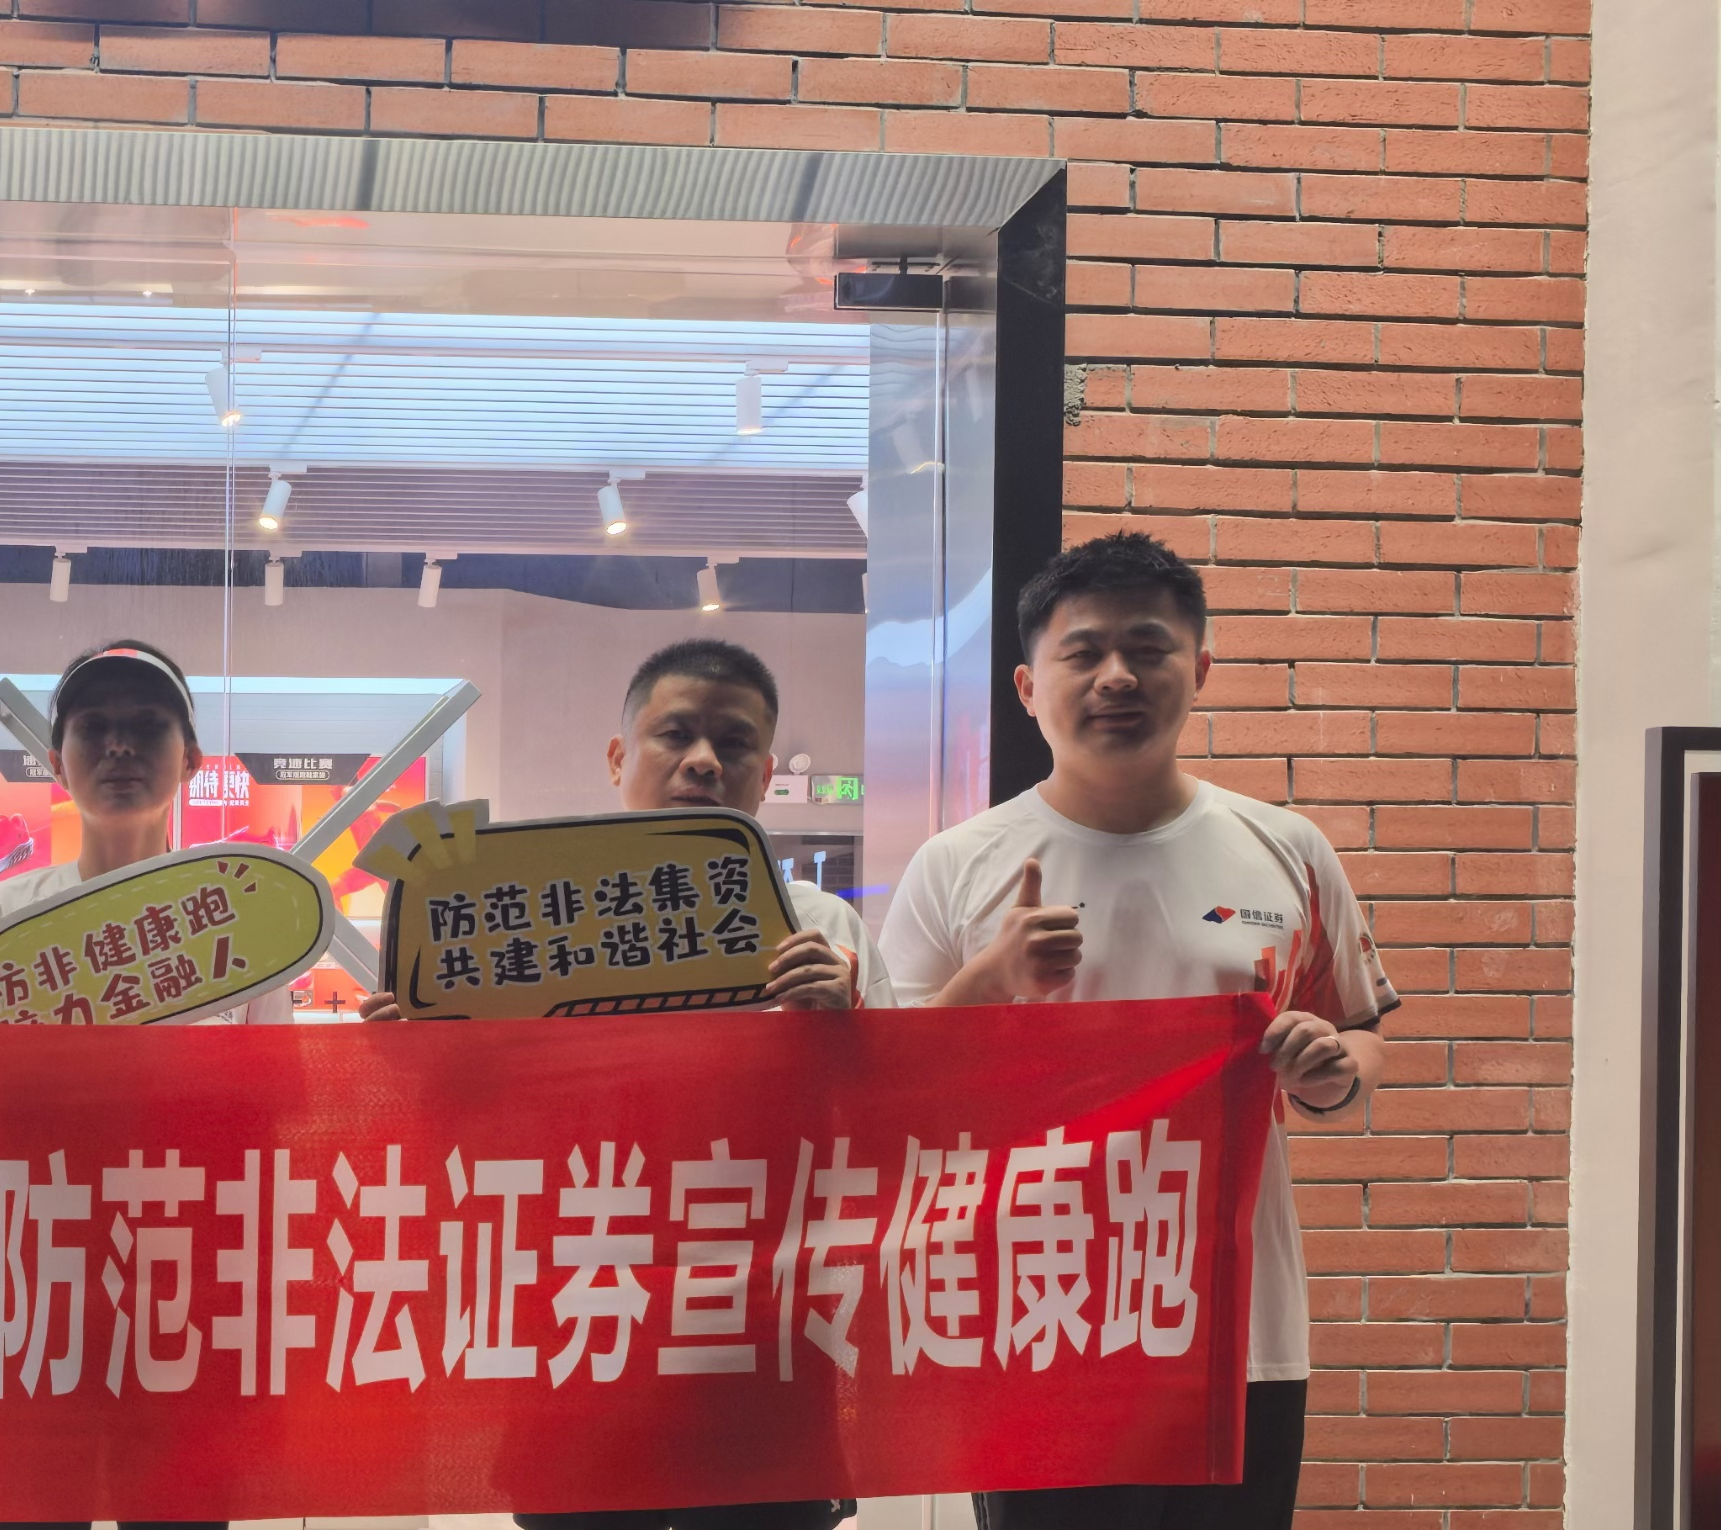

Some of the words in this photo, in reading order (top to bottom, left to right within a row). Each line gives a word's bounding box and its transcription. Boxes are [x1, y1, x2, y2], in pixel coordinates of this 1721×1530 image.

[273, 758, 333, 769] 竞速比赛
[189, 770, 250, 799] 期待更快
[430, 857, 750, 941] 防范非法集资
[1240, 908, 1284, 924] 国信证券
[436, 909, 760, 990] 共建和谐社会
